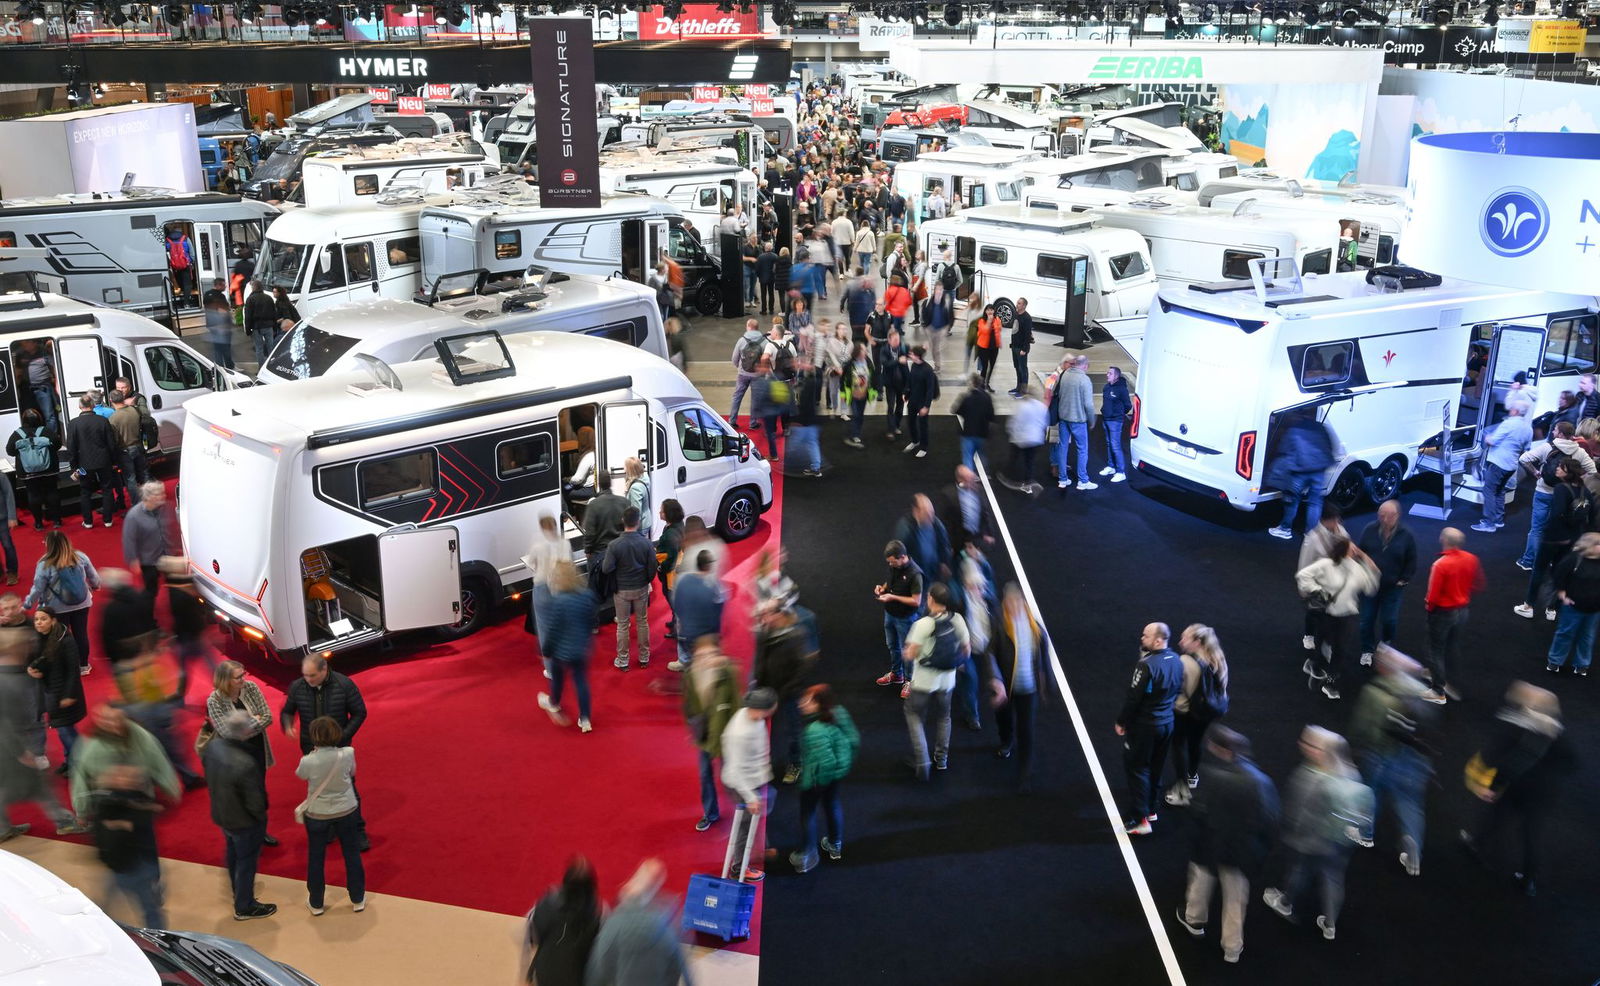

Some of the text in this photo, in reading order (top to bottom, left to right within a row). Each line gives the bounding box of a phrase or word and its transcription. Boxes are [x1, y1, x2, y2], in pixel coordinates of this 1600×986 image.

[655, 17, 741, 34] Dethleffs
[1383, 40, 1425, 56] Camp
[339, 58, 428, 76] HYMER
[1116, 57, 1203, 78] ERIBA
[368, 88, 389, 100] Neu
[429, 84, 450, 96] Neu
[556, 30, 573, 157] SIGNATURE
[695, 87, 719, 99] Neu
[745, 84, 767, 95] Neu
[398, 99, 423, 110] Neu
[753, 100, 775, 112] Neu
[276, 365, 300, 377] BÜRSTN
